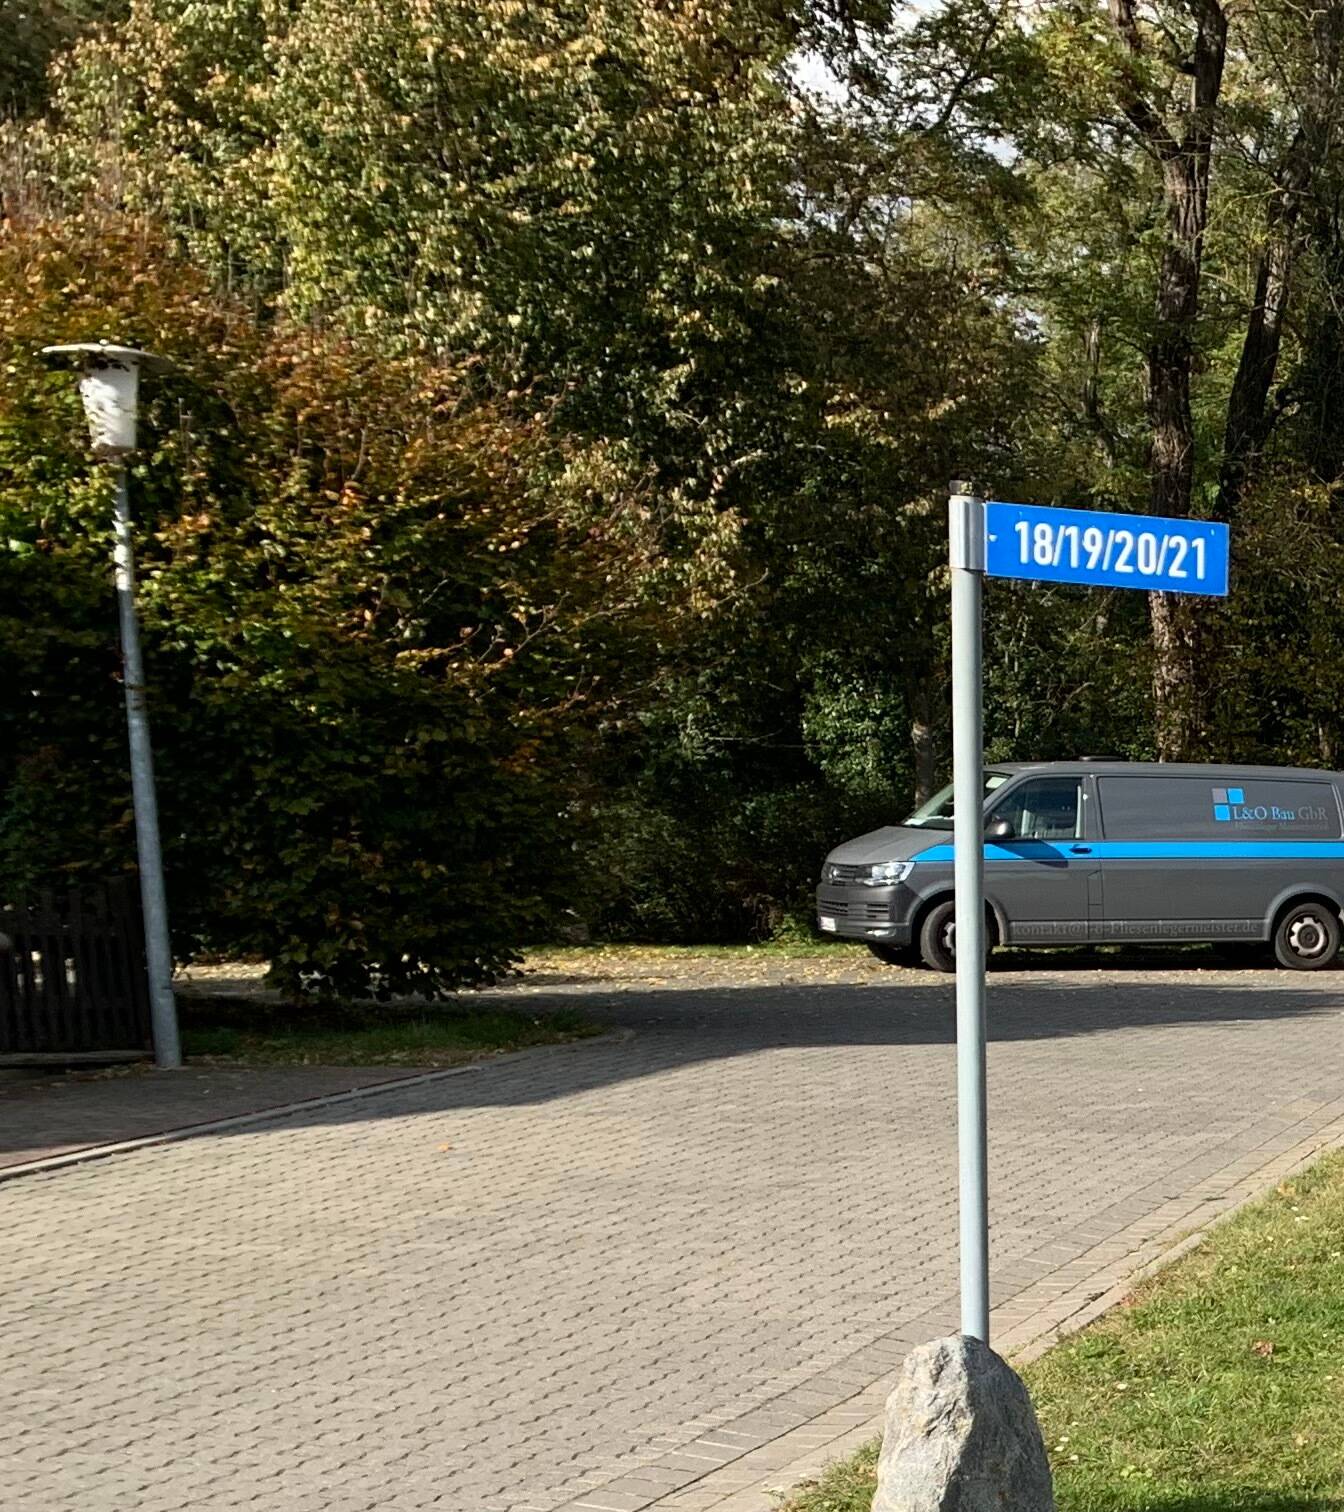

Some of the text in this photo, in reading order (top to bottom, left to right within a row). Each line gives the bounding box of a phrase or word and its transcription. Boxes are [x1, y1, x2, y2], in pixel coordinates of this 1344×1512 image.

[1014, 520, 1206, 580] 18/19/20/21
[1232, 806, 1328, 821] L&O Bau GbR
